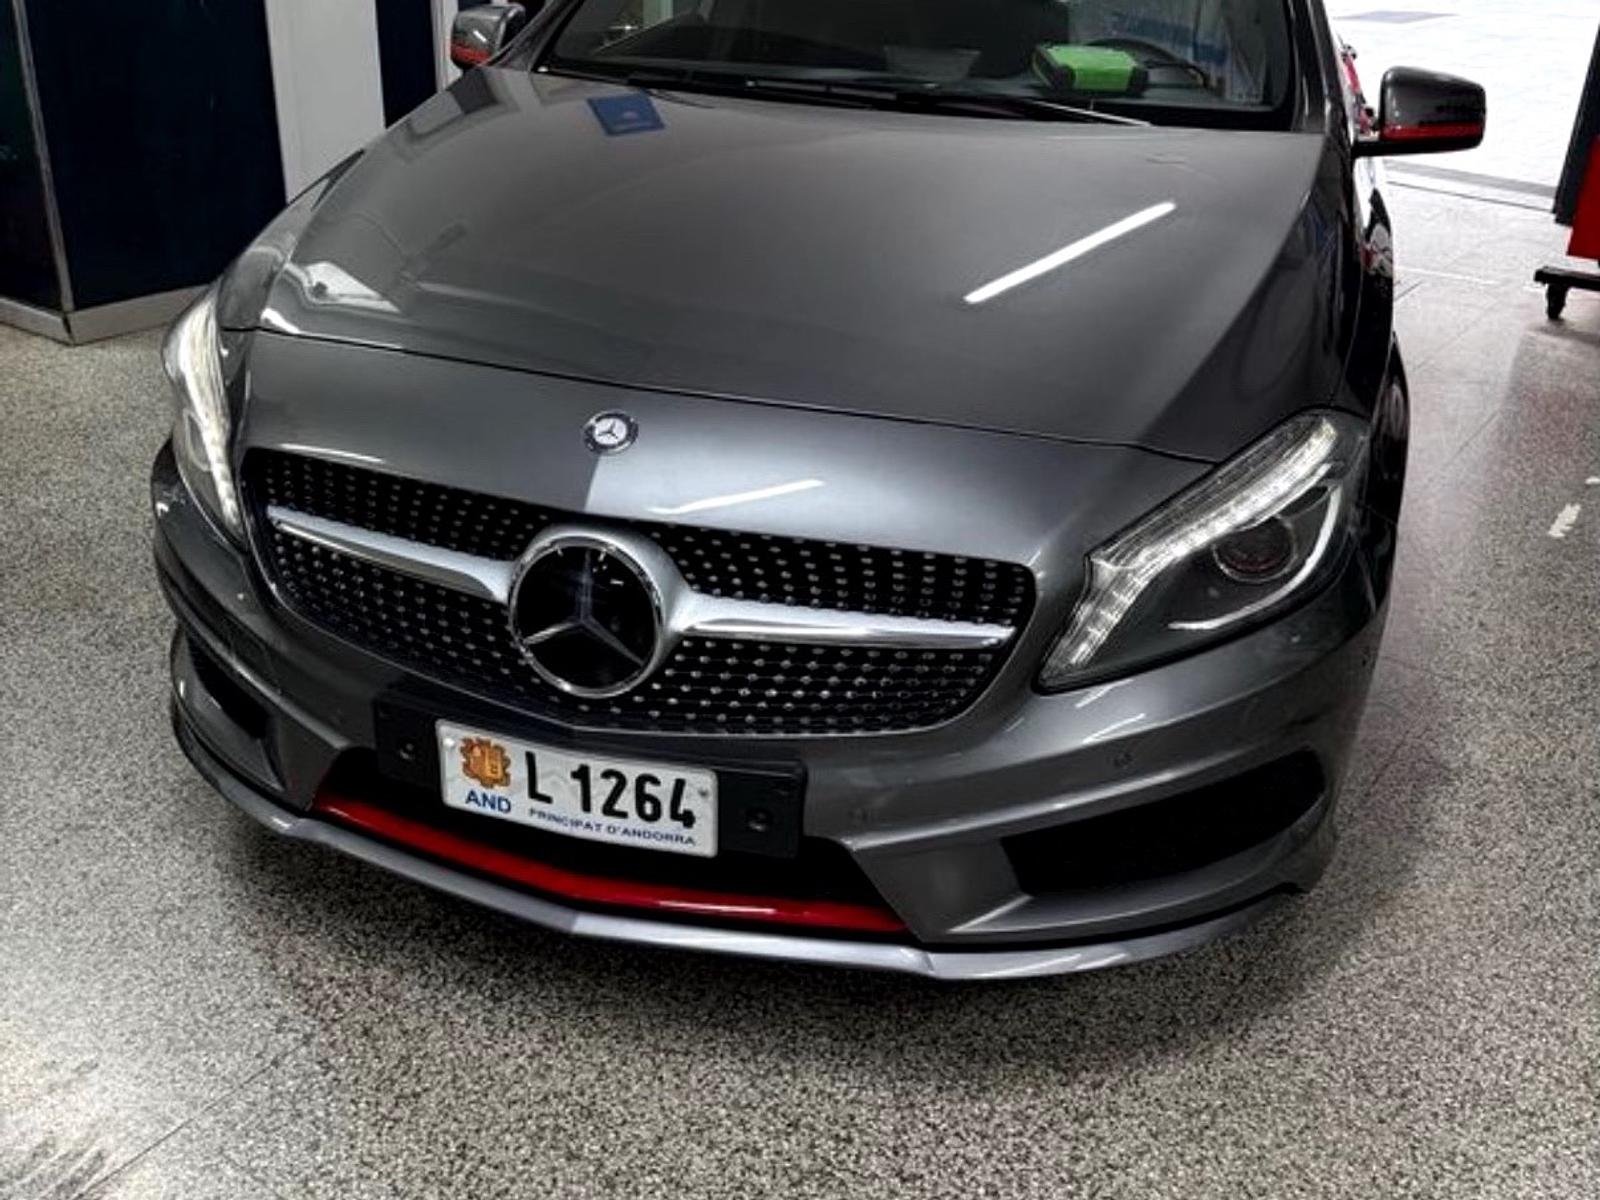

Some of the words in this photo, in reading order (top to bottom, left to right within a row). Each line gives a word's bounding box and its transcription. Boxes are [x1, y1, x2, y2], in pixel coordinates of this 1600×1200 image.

[465, 789, 511, 814] AND
[525, 750, 553, 804] L
[570, 763, 696, 828] 1264
[529, 806, 601, 832] PRINCIPAT
[607, 825, 696, 846] D'ANDORRA
